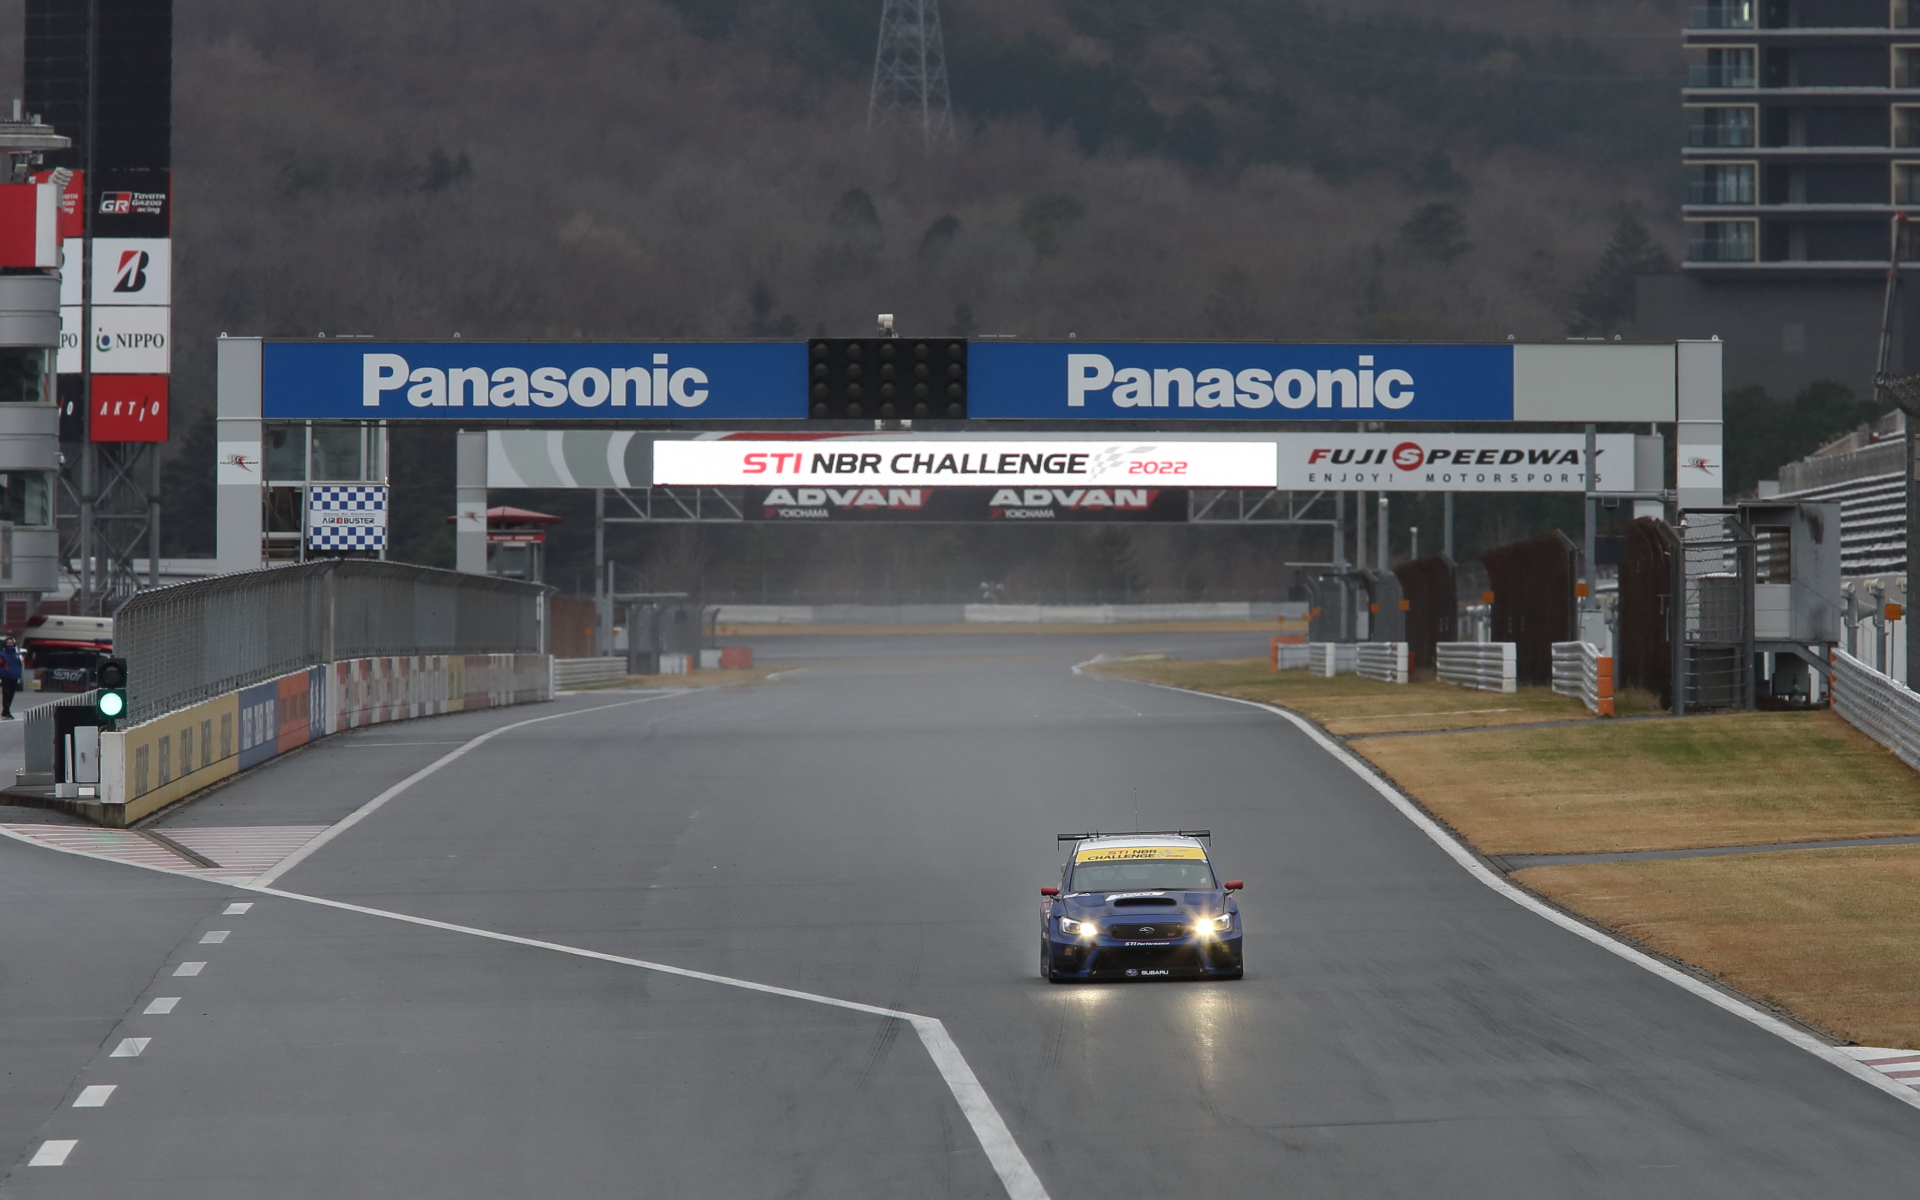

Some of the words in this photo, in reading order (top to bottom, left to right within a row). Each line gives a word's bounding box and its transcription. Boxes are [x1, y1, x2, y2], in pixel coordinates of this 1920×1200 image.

[101, 200, 129, 211] GR
[116, 333, 164, 348] NIPPO
[363, 353, 709, 407] Panasonic
[1068, 353, 1414, 409] Panasonic
[742, 453, 803, 474] STI
[811, 453, 882, 474] NBR
[890, 453, 1090, 474] CHALLENGE
[1128, 461, 1188, 475] 2022
[1308, 473, 1393, 482] ENJOY!
[1426, 473, 1602, 483] MOTORSPORTS
[763, 488, 923, 507] ADVAN
[989, 489, 1150, 507] ADVAN
[778, 509, 829, 518] YOKOHAMA
[1004, 509, 1055, 519] YOKOHAMA
